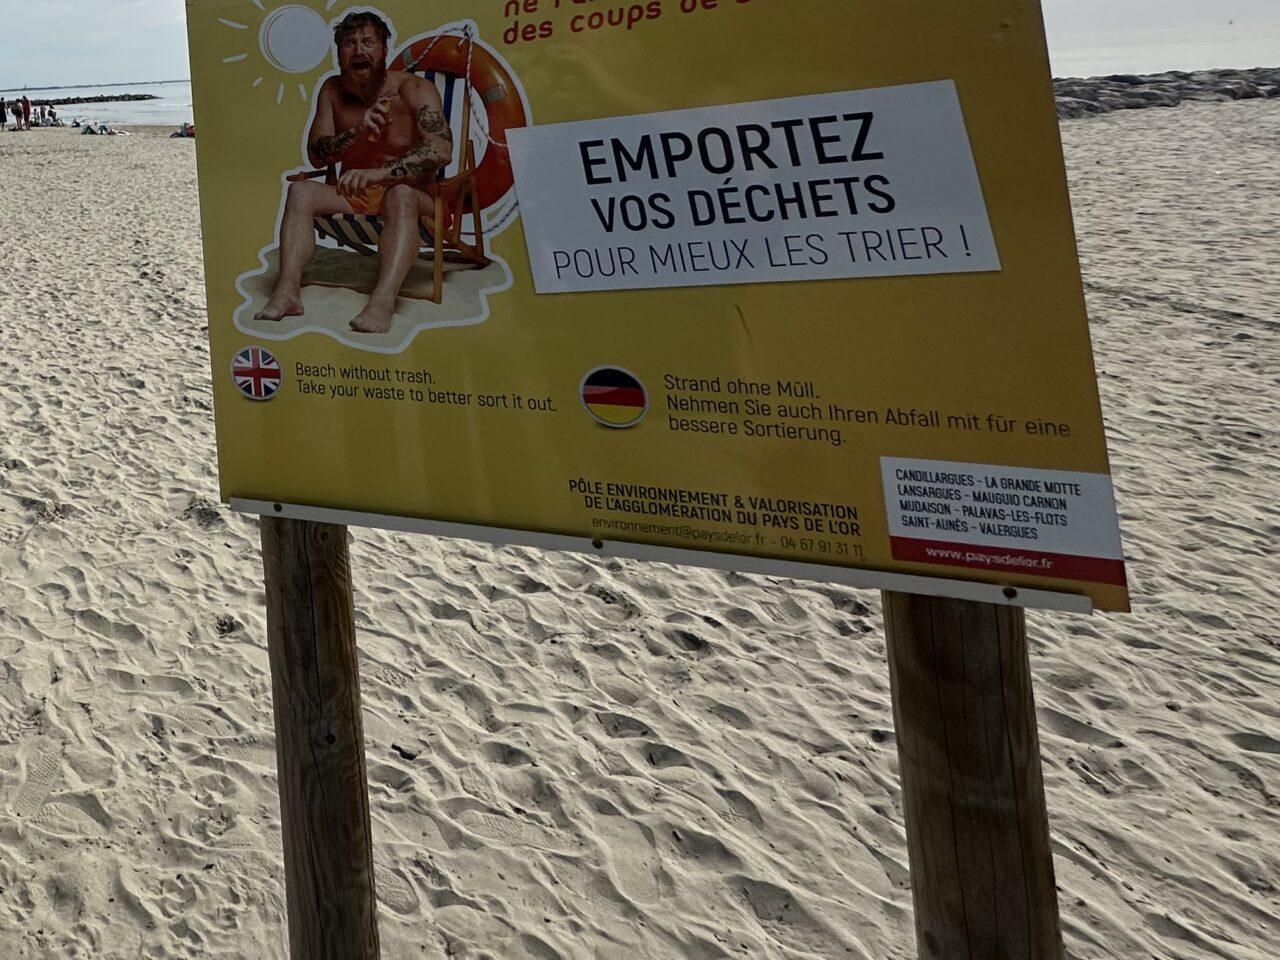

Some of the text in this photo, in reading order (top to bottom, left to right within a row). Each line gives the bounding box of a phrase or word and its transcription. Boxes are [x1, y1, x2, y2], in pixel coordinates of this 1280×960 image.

[502, 18, 554, 46] des
[570, 0, 662, 31] coups
[578, 111, 884, 186] EMPORTEZ
[590, 174, 896, 233] VOS DÉCHETS
[553, 224, 972, 280] POUR MIEUX LES TRIER !
[295, 362, 437, 385] Beach without trash.
[664, 374, 820, 399] Strand ohne Müll.
[296, 379, 558, 412] Take your waste to better sort it out.
[666, 395, 1071, 437] Nehmen Sie auch Ihren Abfall mit für eine
[668, 414, 847, 446] bessere Sortierung.
[895, 469, 974, 487] CANDILLARGUES
[985, 476, 998, 488] LA
[1001, 478, 1042, 492] GRANDE
[1044, 482, 1082, 496] MOTTE
[898, 484, 962, 501] LANSARGUES
[972, 491, 1020, 506] MAUGUIO
[1023, 495, 1067, 510] CARNON
[569, 477, 858, 521] PÔLE ENVIRONNEMENT & VALORISATION
[900, 500, 951, 515] MUDAISON
[963, 506, 1068, 527] PALAVAS-LES-FLOTS
[584, 496, 862, 537] DE L'AGGLOMÉRATION DU PAYS DE L'OR
[901, 515, 969, 533] SAINT-AUNÈS
[980, 523, 1038, 540] VALERGUES
[780, 536, 796, 549] 04
[800, 538, 814, 551] 67
[818, 540, 832, 554] 91
[835, 542, 848, 556] 31
[852, 544, 864, 557] 11
